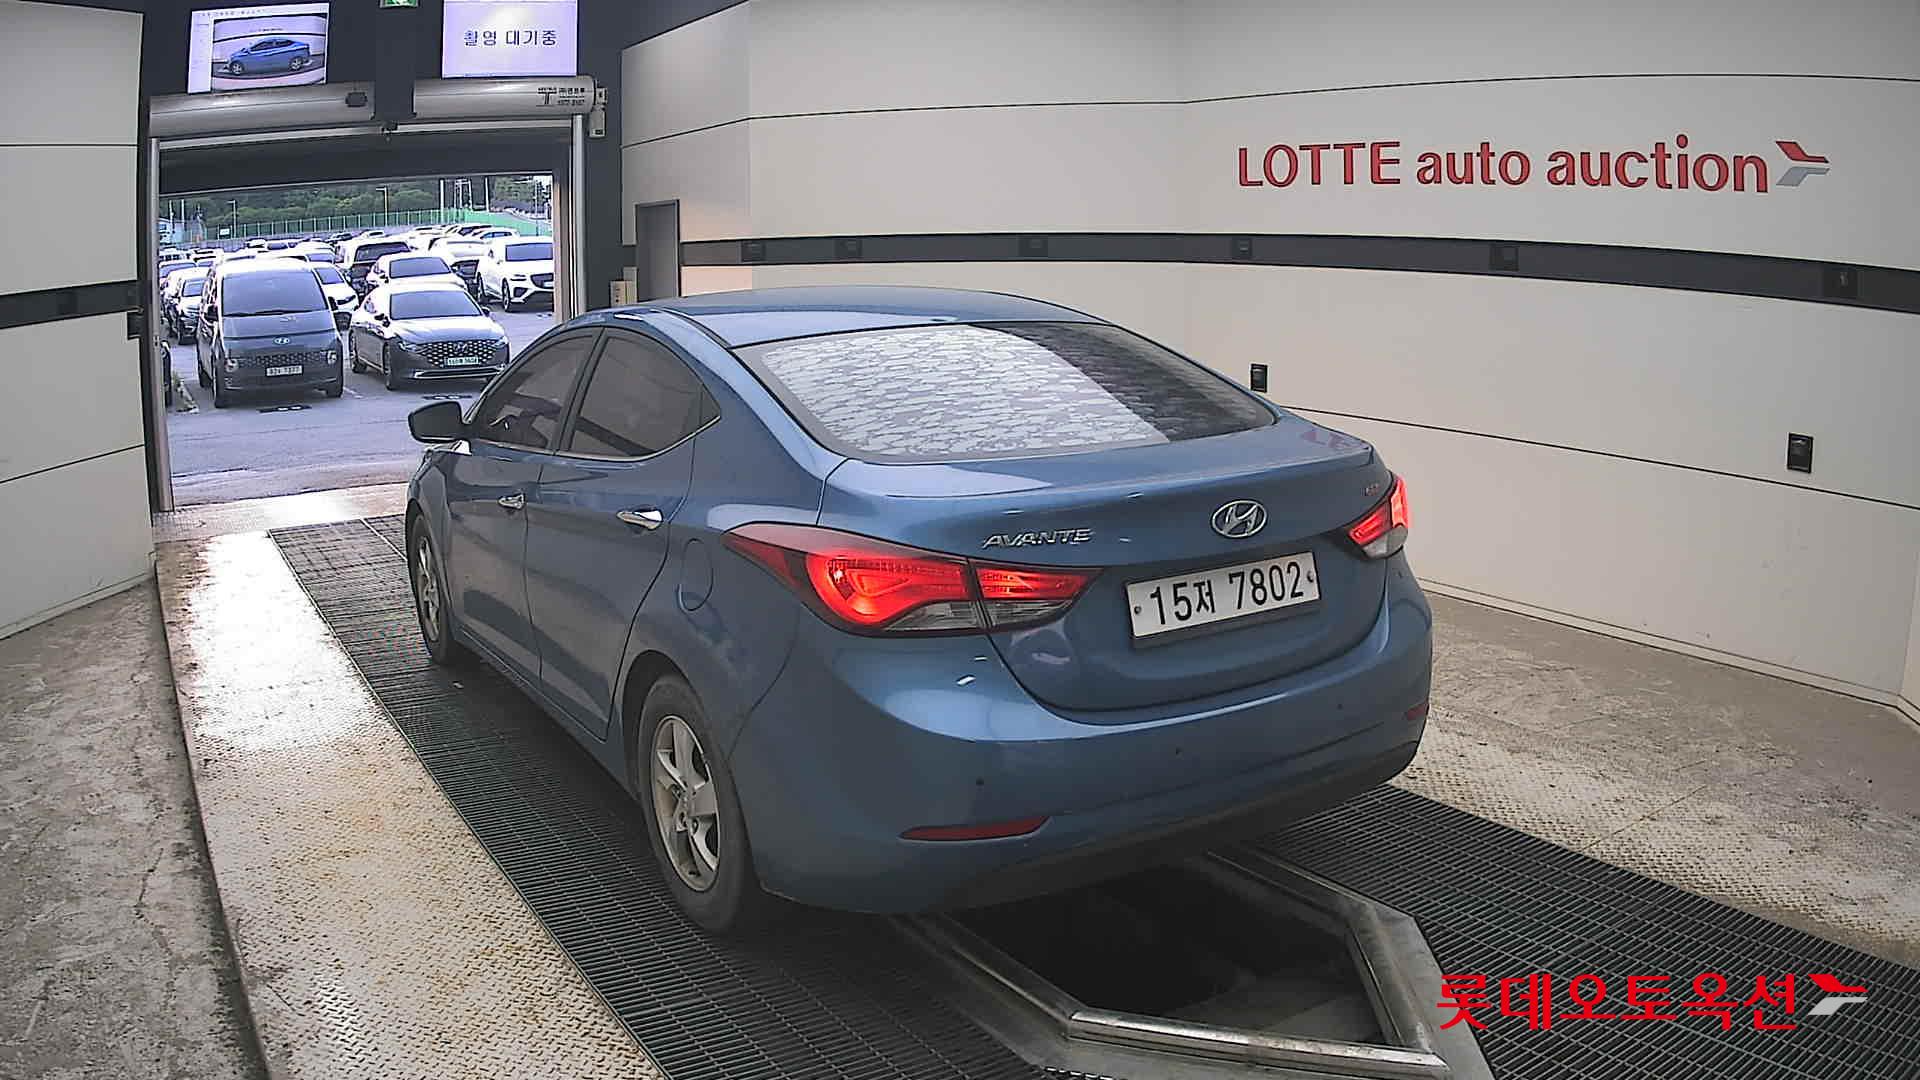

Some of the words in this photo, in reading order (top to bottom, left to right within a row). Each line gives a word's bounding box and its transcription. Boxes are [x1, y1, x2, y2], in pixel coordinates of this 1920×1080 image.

[505, 29, 557, 47] 대기중
[1238, 141, 1401, 187] LOTTE
[1415, 141, 1532, 186] auto
[1546, 134, 1769, 194] auction
[982, 527, 1094, 549] AVANTE
[1150, 579, 1216, 625] 15저
[1228, 560, 1305, 611] 7802
